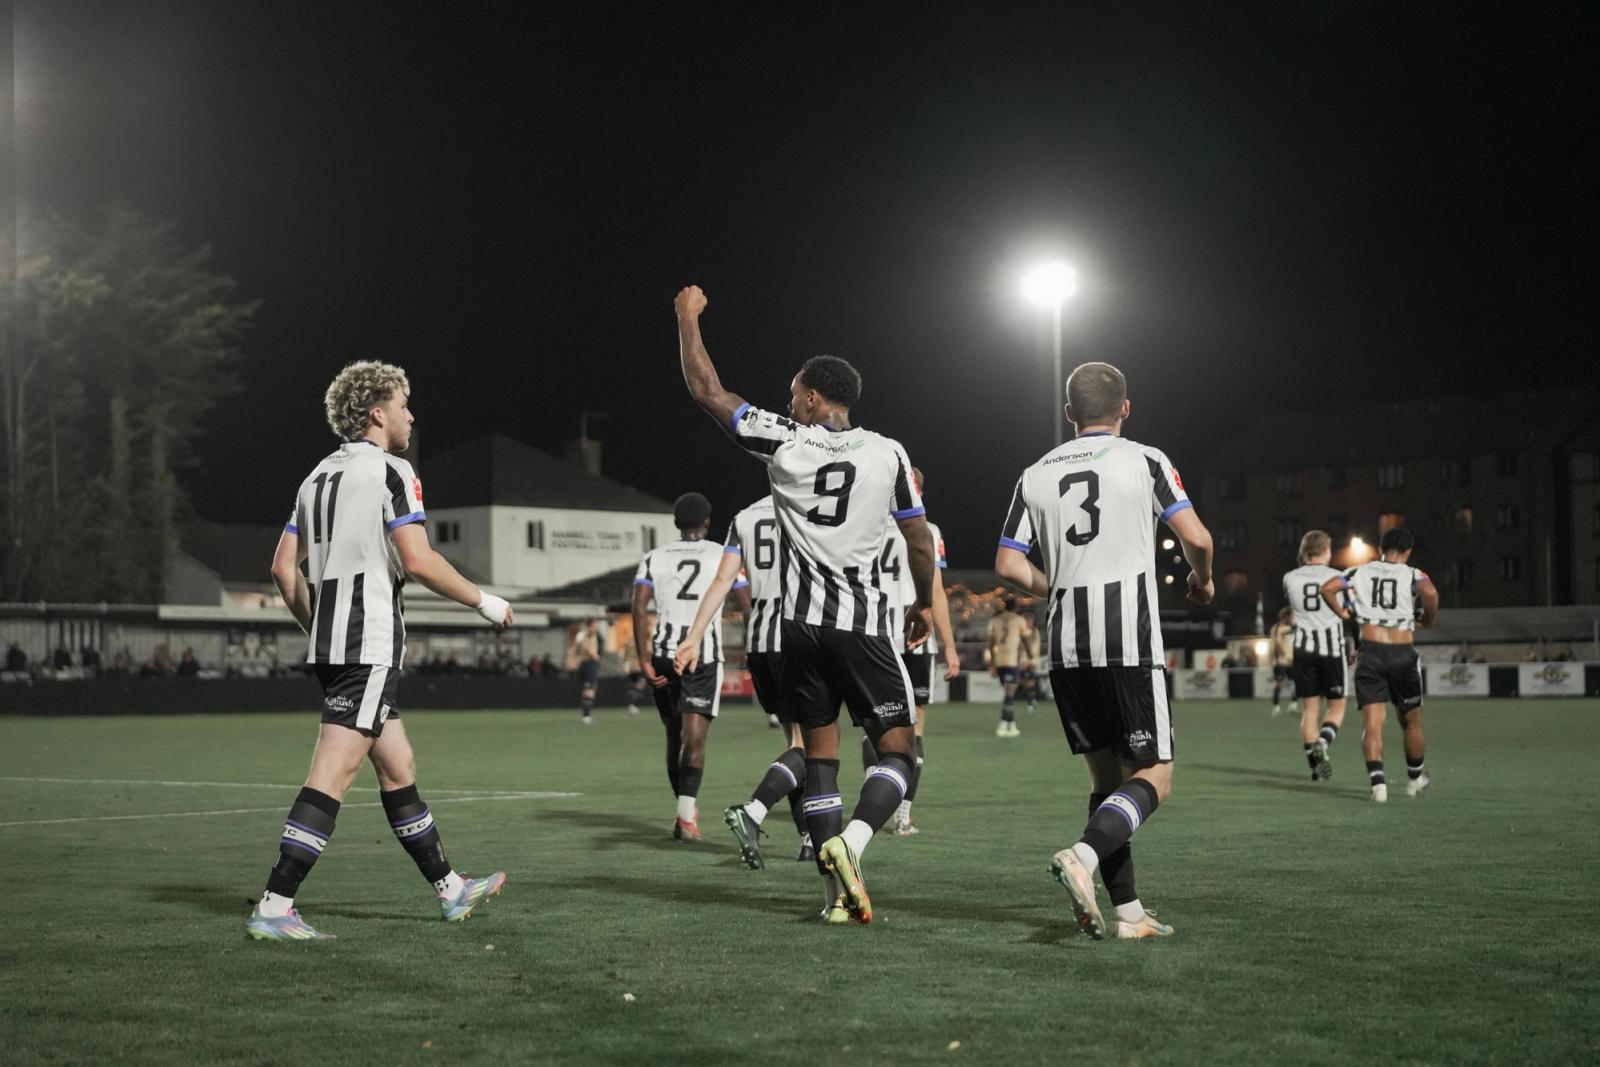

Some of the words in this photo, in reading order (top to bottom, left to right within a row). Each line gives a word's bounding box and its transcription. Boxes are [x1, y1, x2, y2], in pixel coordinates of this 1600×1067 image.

[1042, 451, 1093, 466] Anderson
[312, 471, 344, 544] 11
[807, 461, 857, 527] 9
[1059, 469, 1100, 547] 3
[755, 518, 776, 569] 6
[880, 537, 901, 581] 4
[677, 559, 701, 600] 2
[1303, 582, 1321, 612] 8
[1371, 577, 1398, 609] 10
[395, 821, 427, 836] TFC
